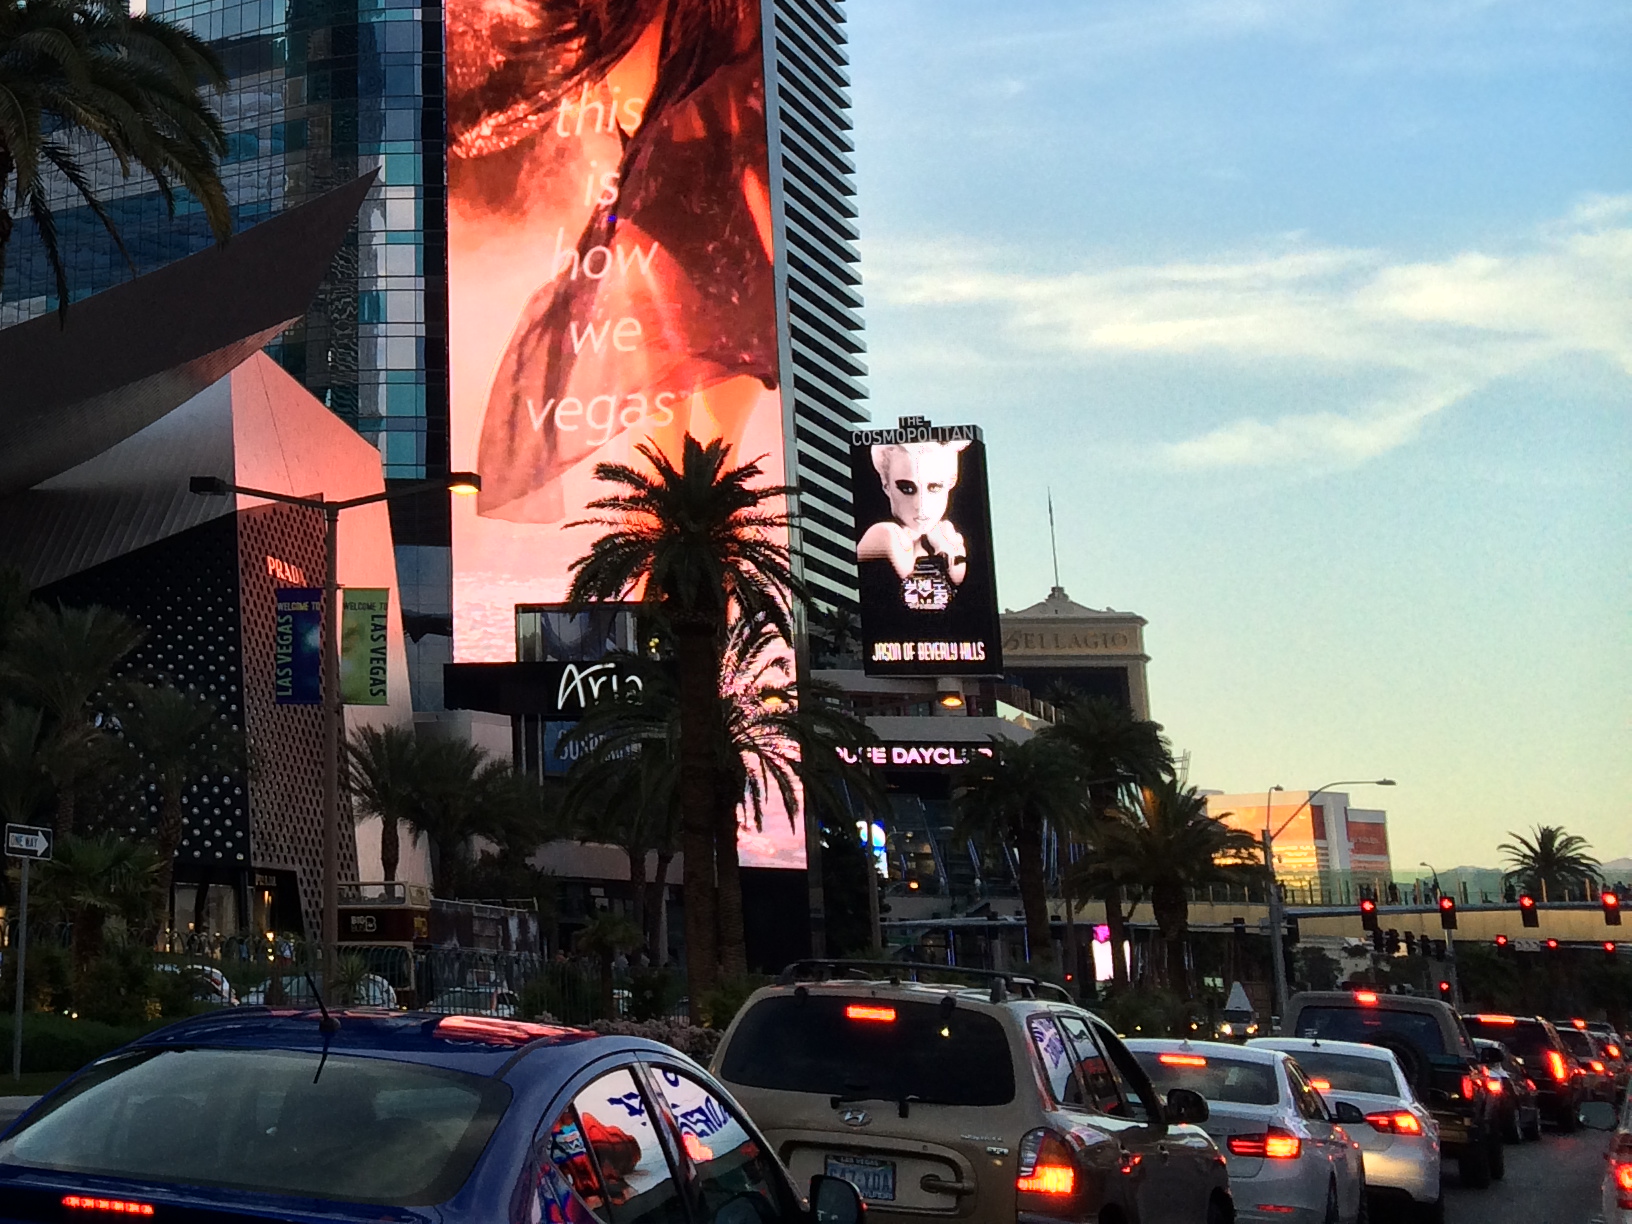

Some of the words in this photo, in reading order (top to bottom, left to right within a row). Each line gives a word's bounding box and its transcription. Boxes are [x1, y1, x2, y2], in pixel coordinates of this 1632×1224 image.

[556, 81, 644, 138] this
[583, 159, 620, 207] is
[550, 227, 660, 281] how
[569, 316, 643, 356] we
[526, 390, 676, 447] vegas
[901, 416, 924, 427] THE
[852, 425, 974, 446] COSMOPOLITAN
[266, 555, 307, 587] PRADA
[277, 601, 310, 611] WELCOME
[311, 601, 321, 611] TO
[277, 614, 293, 665] VEGAS
[370, 614, 387, 646] LAS
[1002, 629, 1128, 651] BELLAGIO
[872, 642, 901, 661] JASON
[903, 642, 915, 661] OF
[917, 642, 958, 661] BEVERLY
[959, 642, 986, 661] HILLS
[277, 667, 292, 697] LAS
[369, 648, 387, 697] VEGAS
[556, 662, 644, 711] Aria
[891, 747, 994, 765] DAYCL
[10, 833, 24, 847] ONE
[25, 836, 38, 849] WAY
